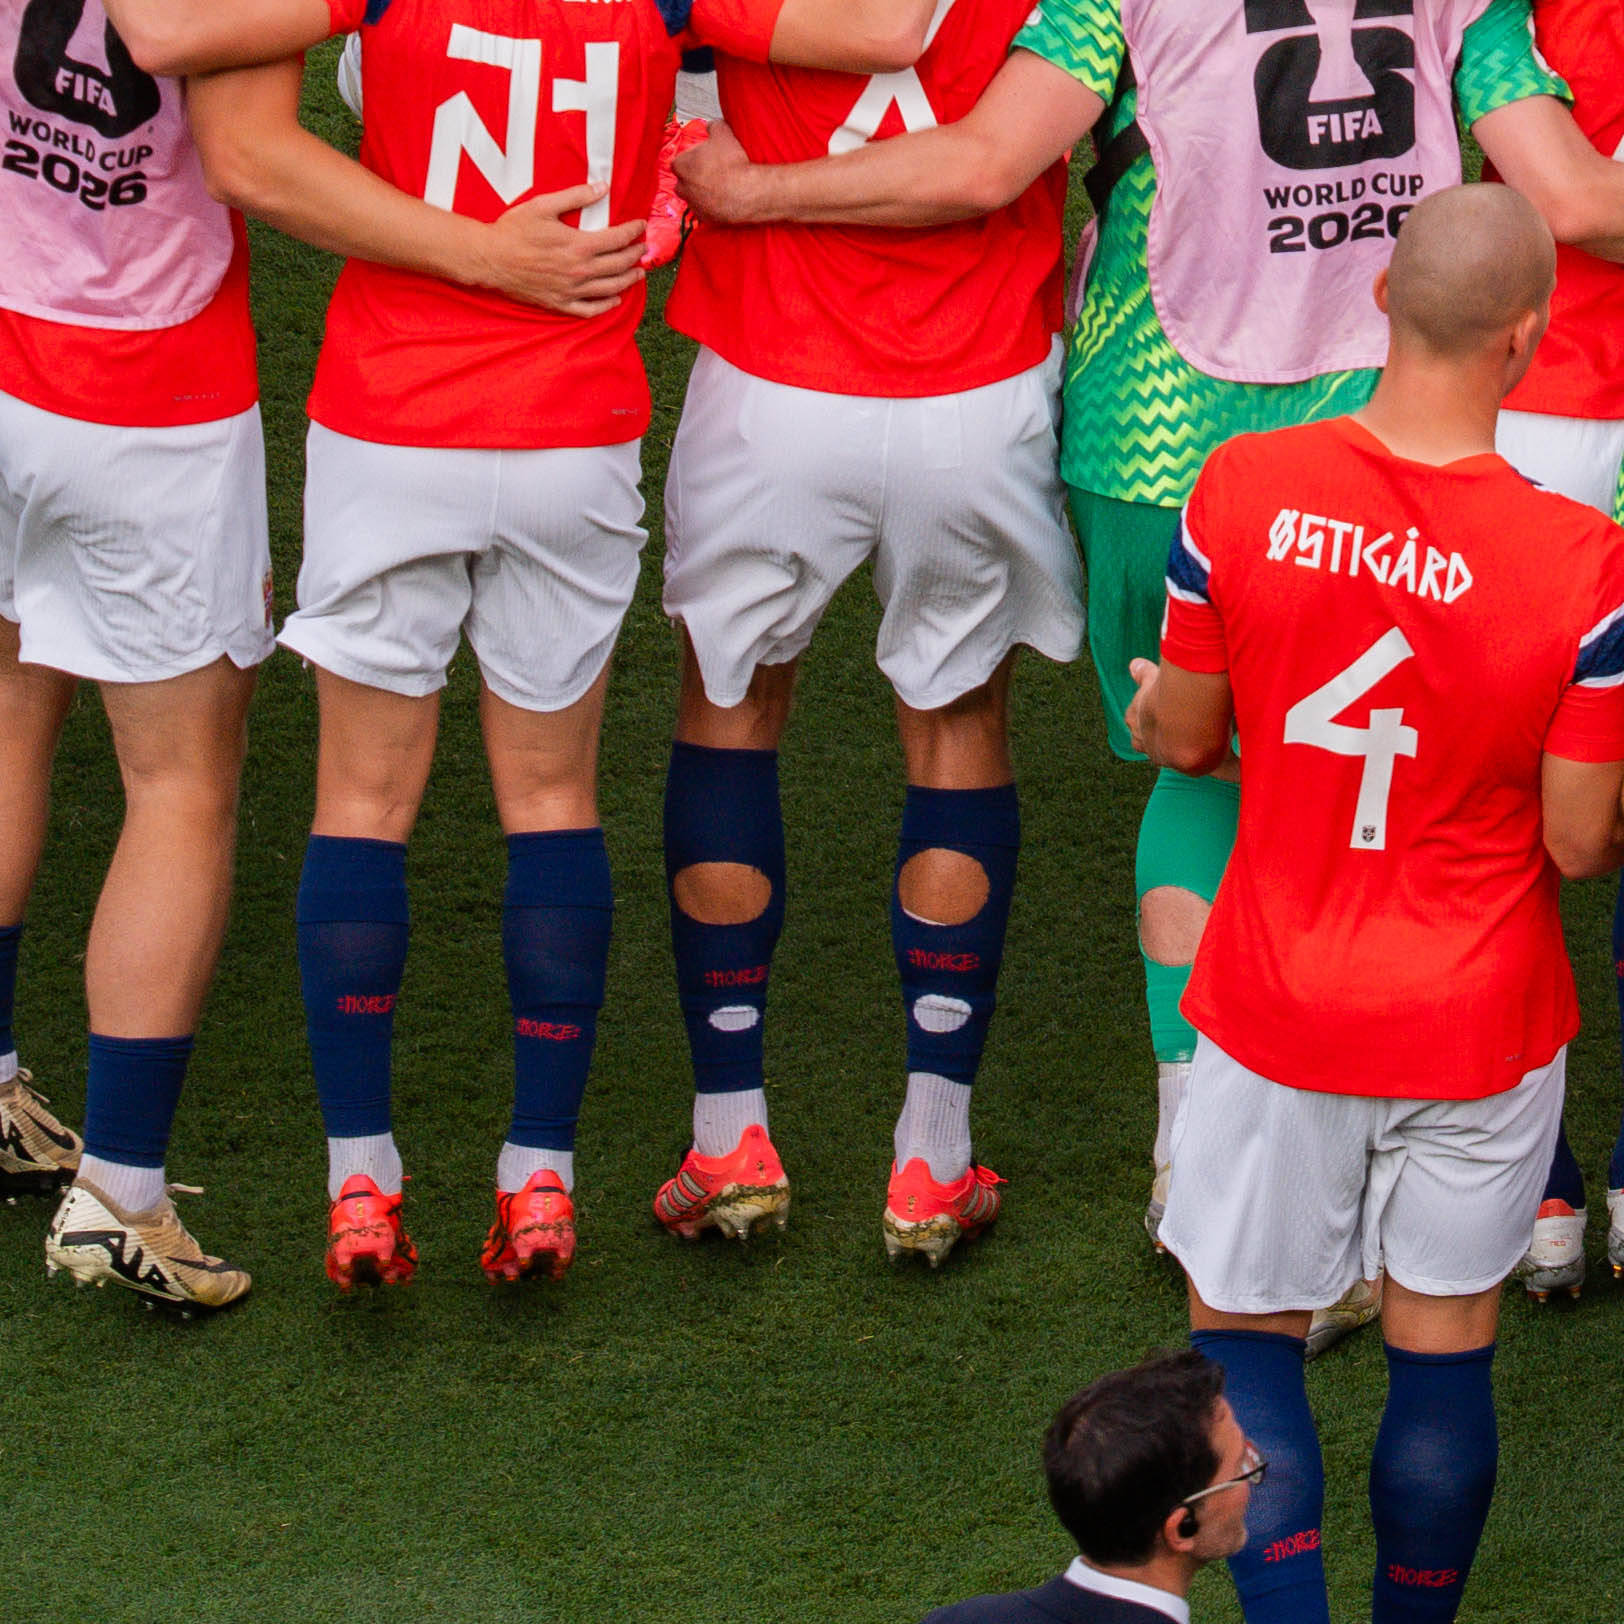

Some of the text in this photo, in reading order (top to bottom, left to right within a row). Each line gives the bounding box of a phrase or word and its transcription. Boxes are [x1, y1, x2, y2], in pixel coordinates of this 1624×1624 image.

[55, 66, 118, 118] FIFA
[8, 110, 153, 172] WORLD CUP
[423, 22, 619, 230] 21
[1306, 108, 1383, 145] FIFA
[1, 139, 148, 211] 2026
[1263, 172, 1424, 209] WORLD CUP
[1266, 508, 1472, 604] ØSTIGÅRD
[1283, 626, 1418, 851] 4
